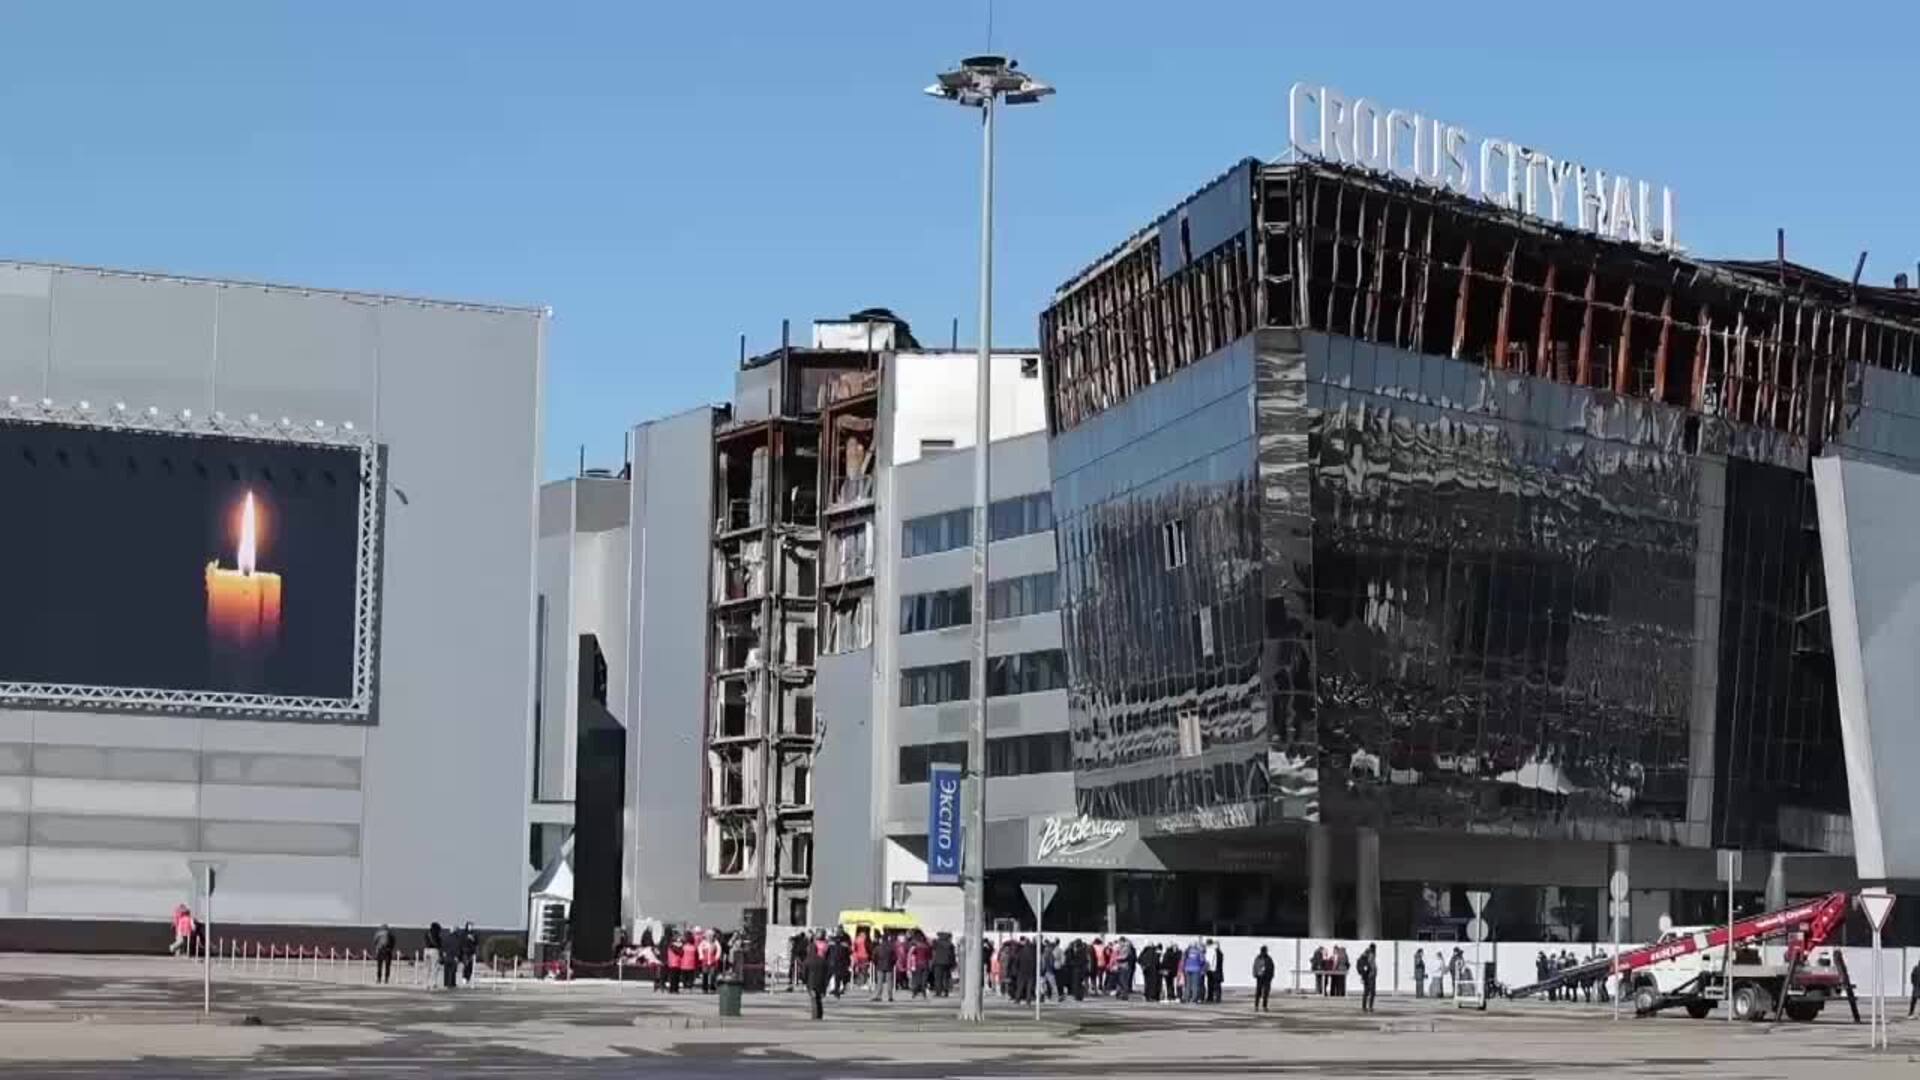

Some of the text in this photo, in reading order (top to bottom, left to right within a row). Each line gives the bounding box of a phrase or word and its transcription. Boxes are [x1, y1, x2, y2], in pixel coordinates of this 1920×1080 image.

[1289, 82, 1682, 252] CROCUS CITY HALL
[1037, 813, 1126, 860] Backstage
[937, 855, 954, 868] 2
